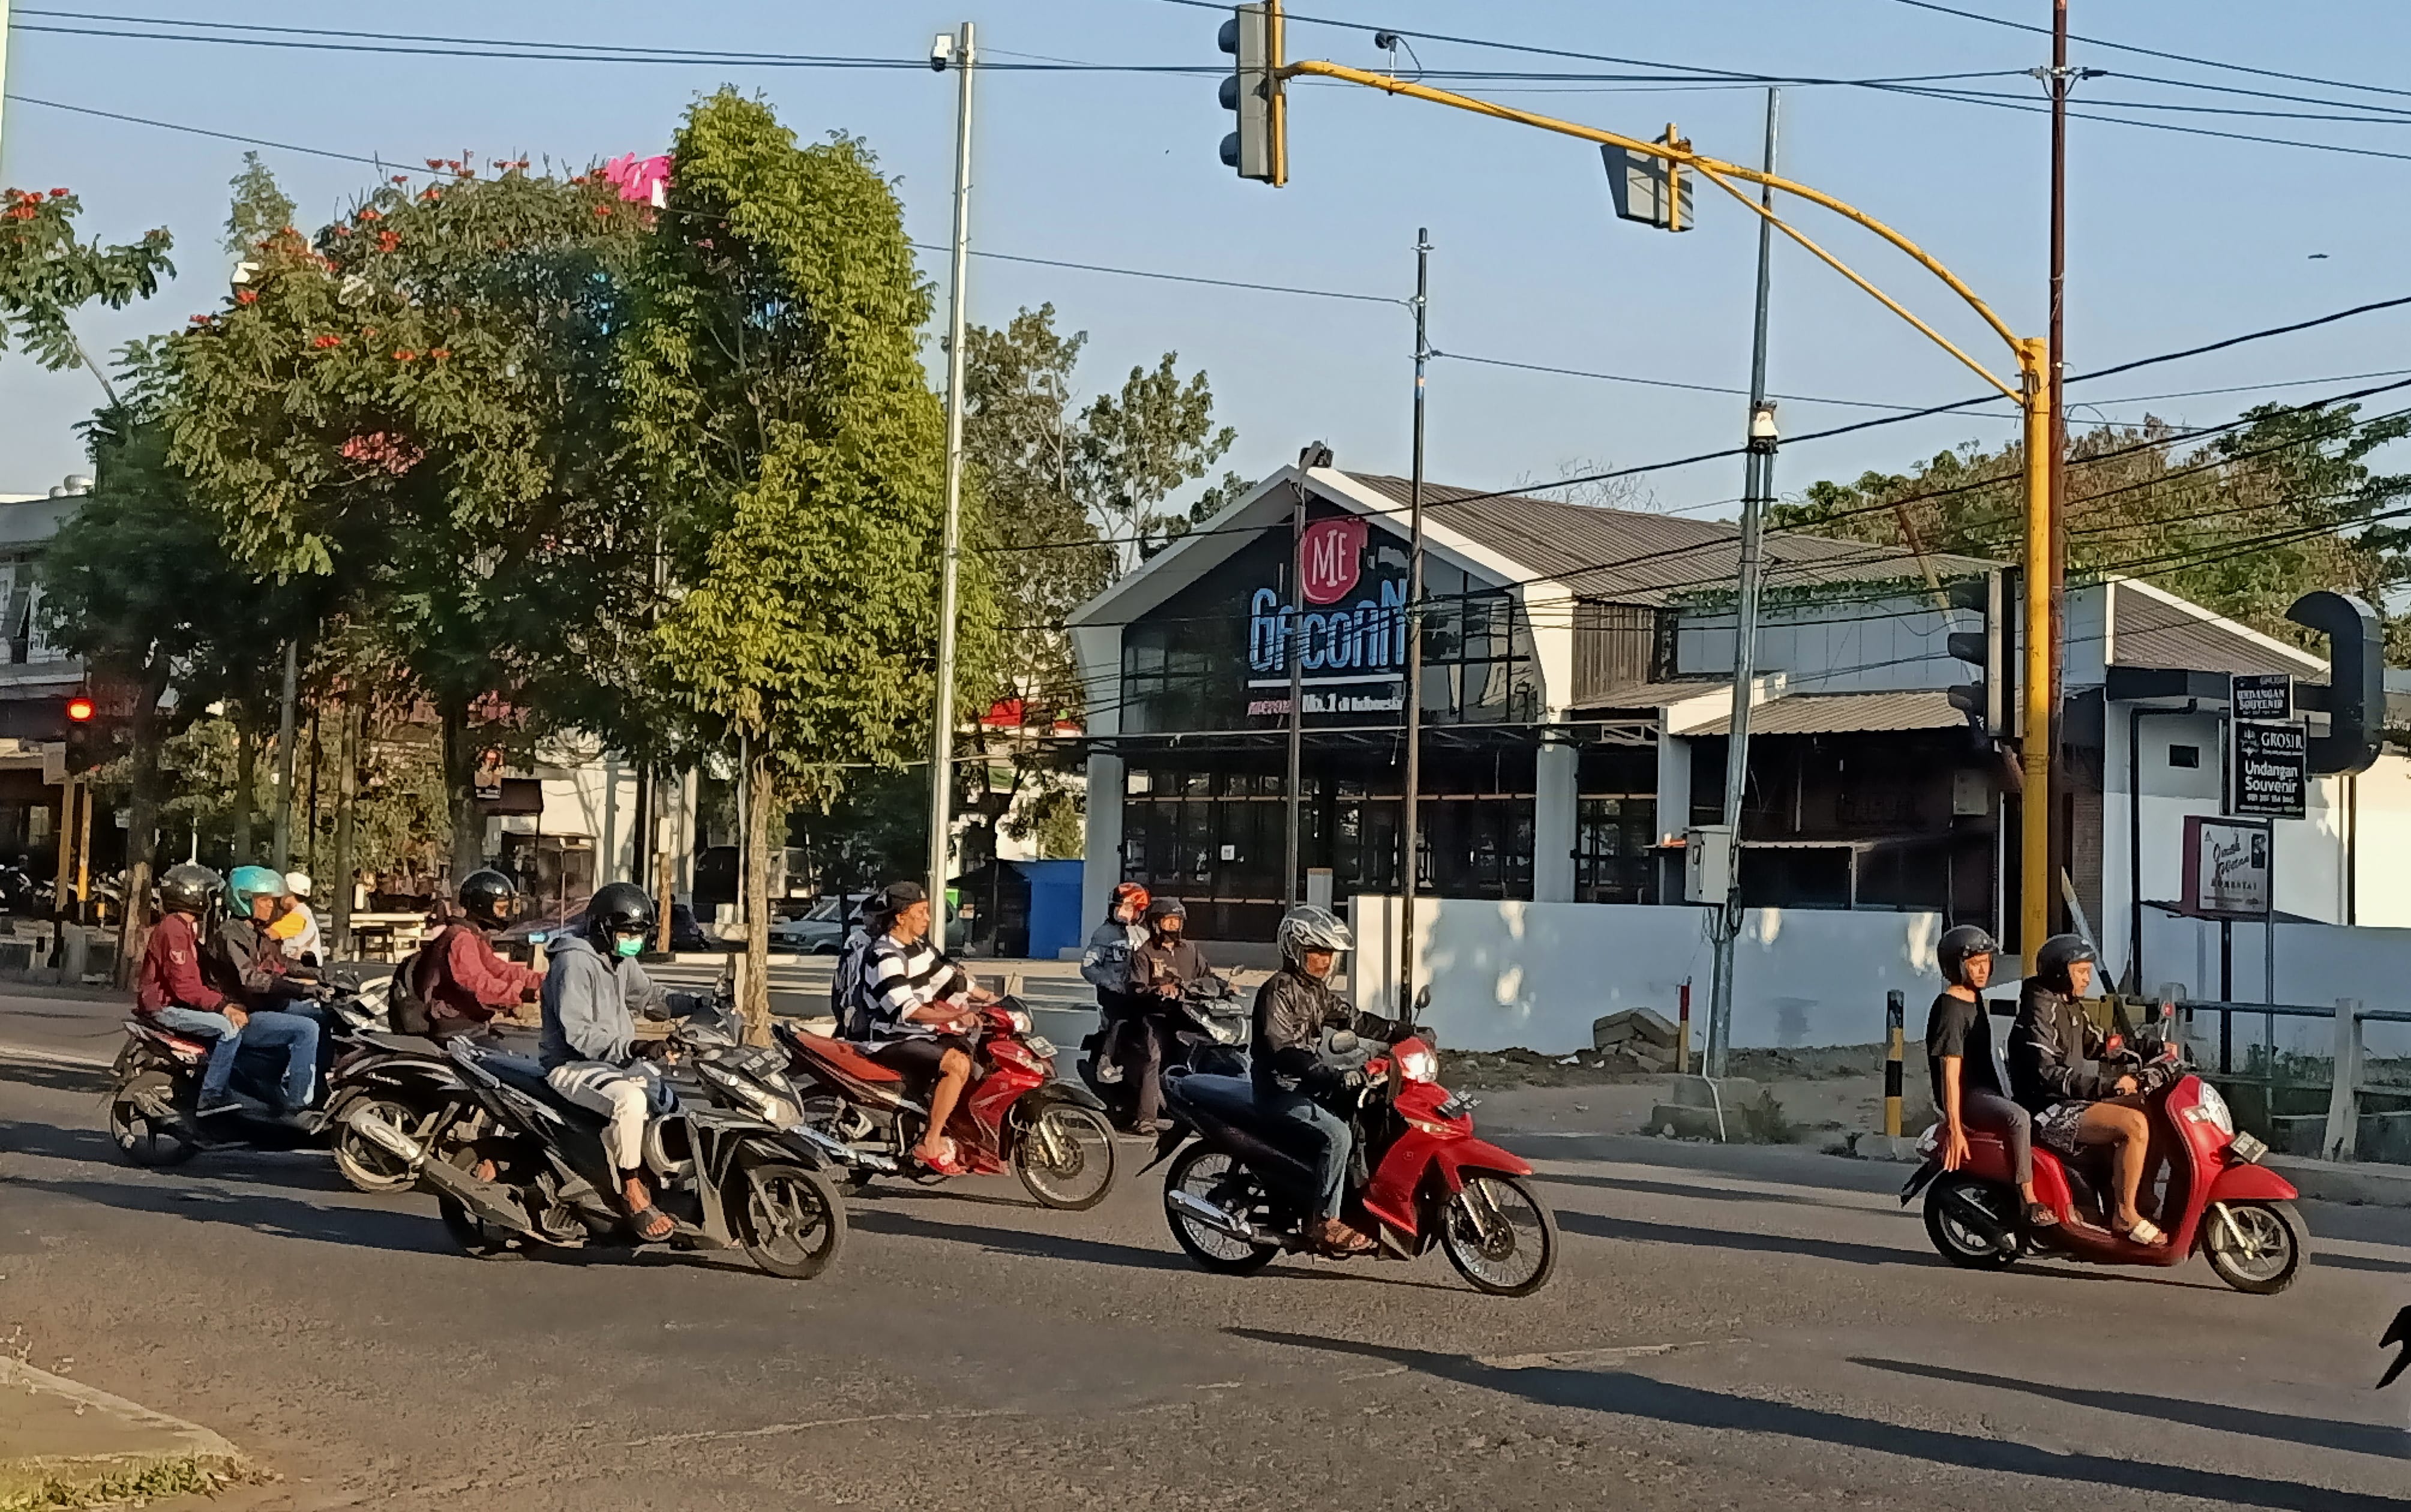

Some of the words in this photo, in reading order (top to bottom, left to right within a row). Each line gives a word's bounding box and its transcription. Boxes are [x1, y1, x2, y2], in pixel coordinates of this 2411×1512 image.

[2261, 731, 2304, 749] GROSIR
[2245, 759, 2298, 781] Undangan
[2245, 775, 2298, 793] Souvenir
